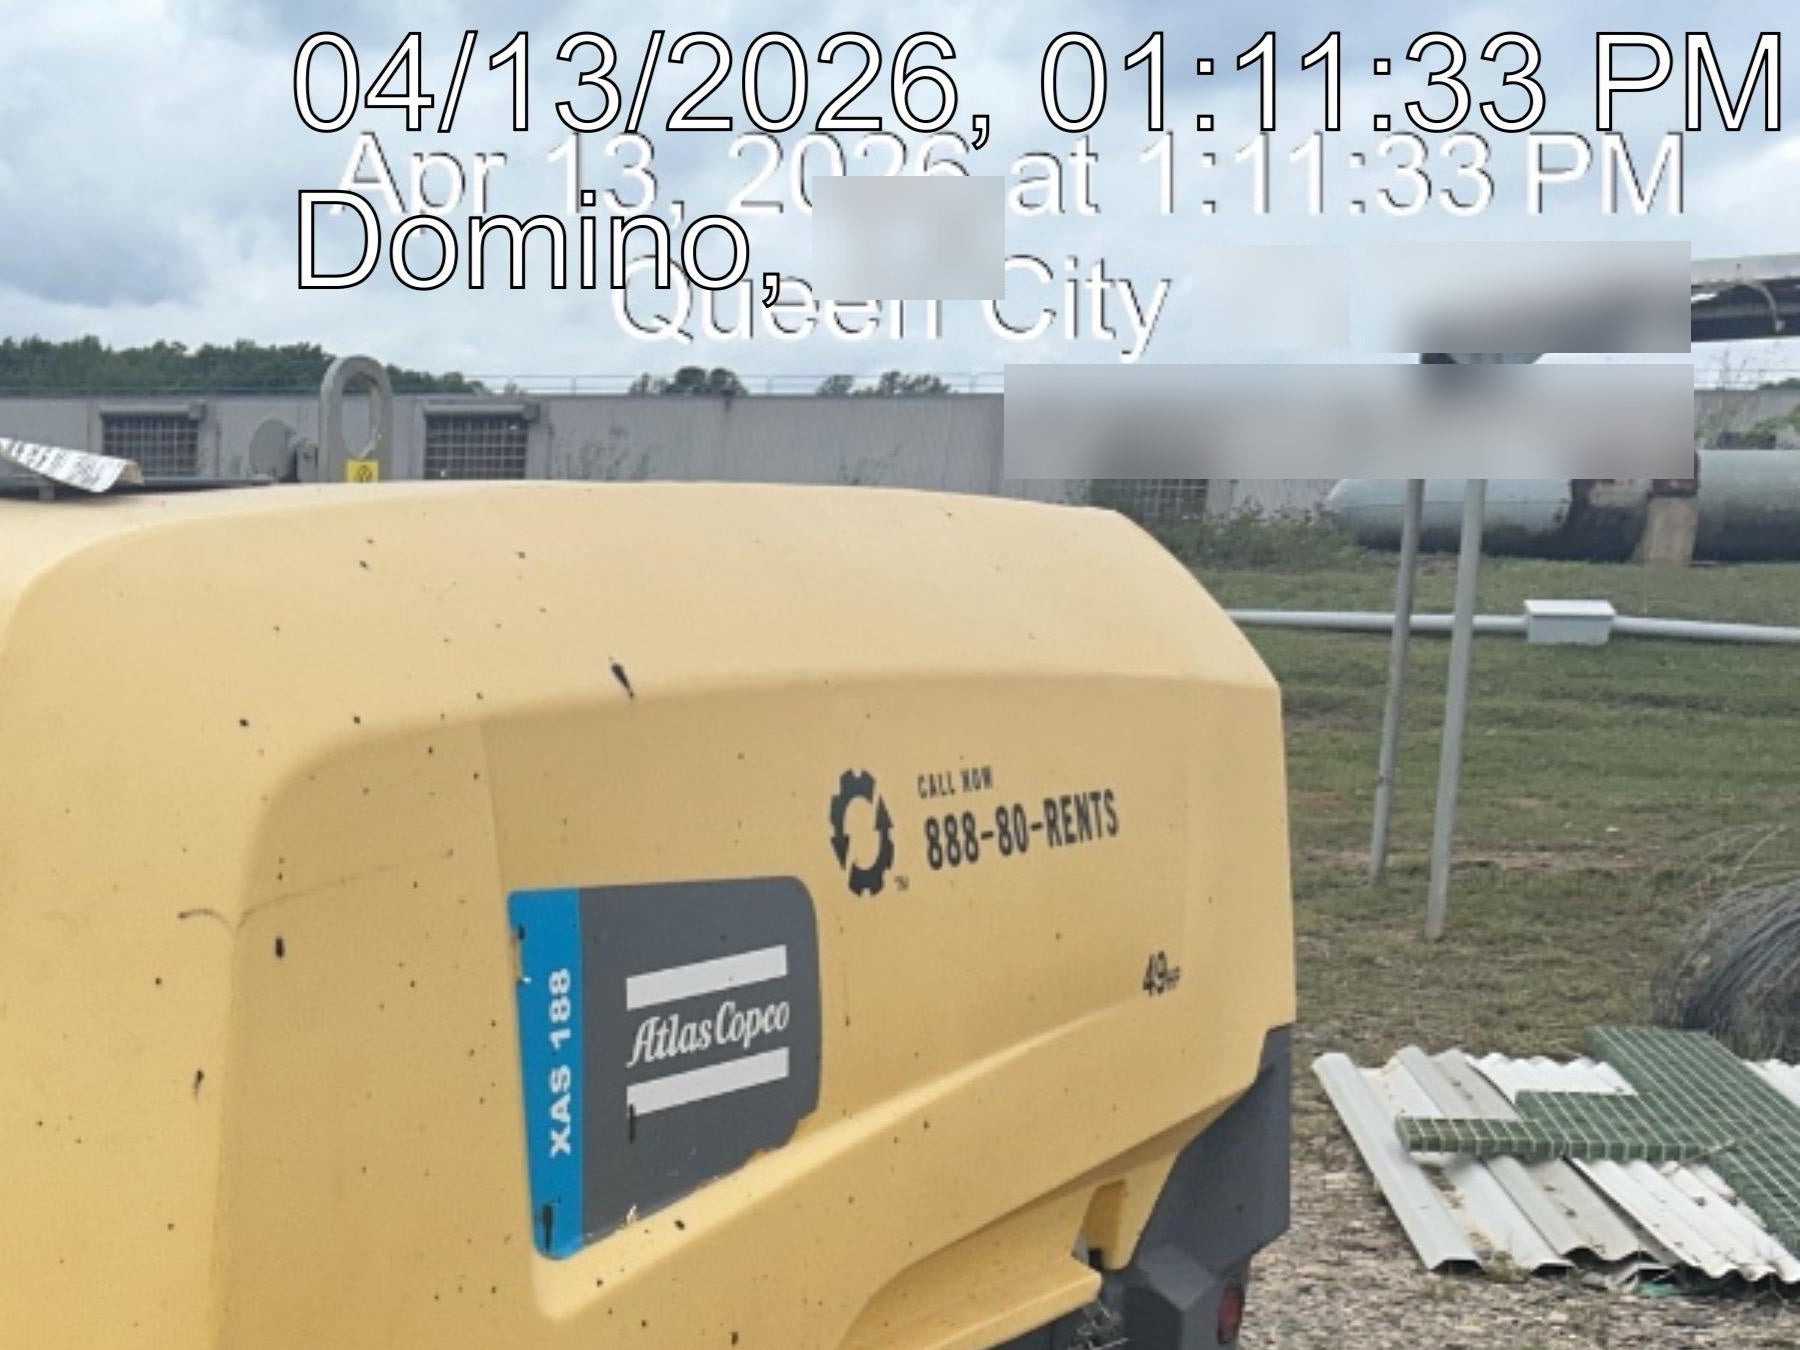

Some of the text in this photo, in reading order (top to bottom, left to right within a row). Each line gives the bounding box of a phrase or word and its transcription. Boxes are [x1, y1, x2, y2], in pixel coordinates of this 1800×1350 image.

[917, 765, 993, 798] CALL NOW
[925, 788, 1119, 870] 888-80-RENTS
[550, 968, 571, 1158] XAS 188
[625, 1001, 790, 1068] Atlas Copco
